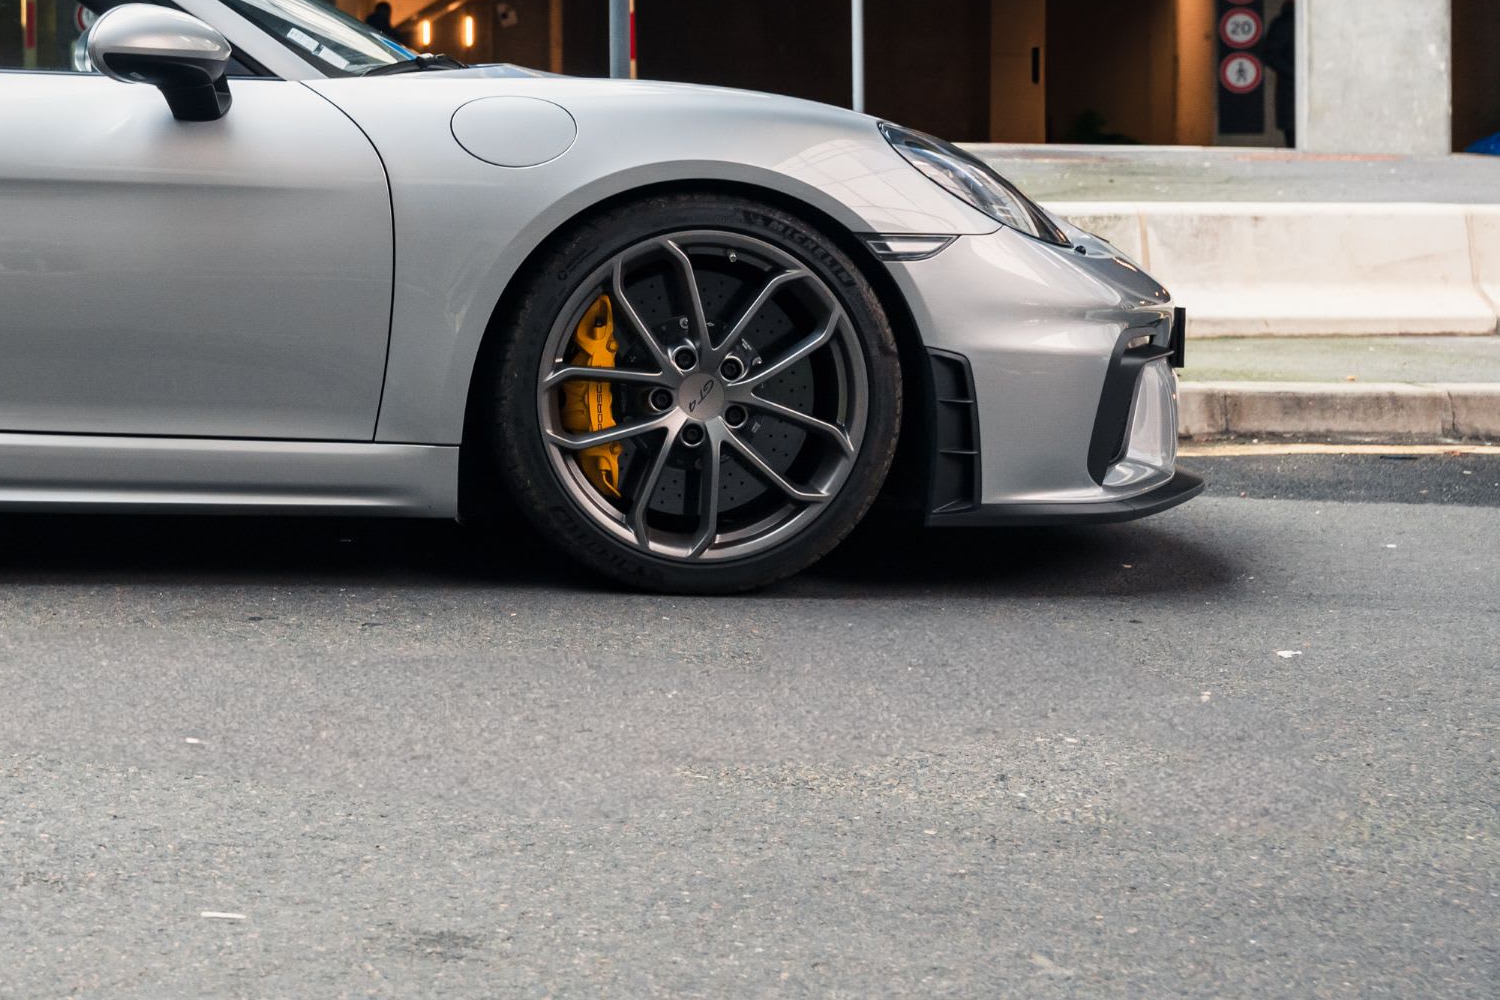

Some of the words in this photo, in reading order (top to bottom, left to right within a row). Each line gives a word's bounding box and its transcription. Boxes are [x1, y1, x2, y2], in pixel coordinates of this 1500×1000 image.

[1230, 21, 1253, 36] 20
[768, 216, 854, 287] MICHELIN
[688, 379, 714, 412] GT4
